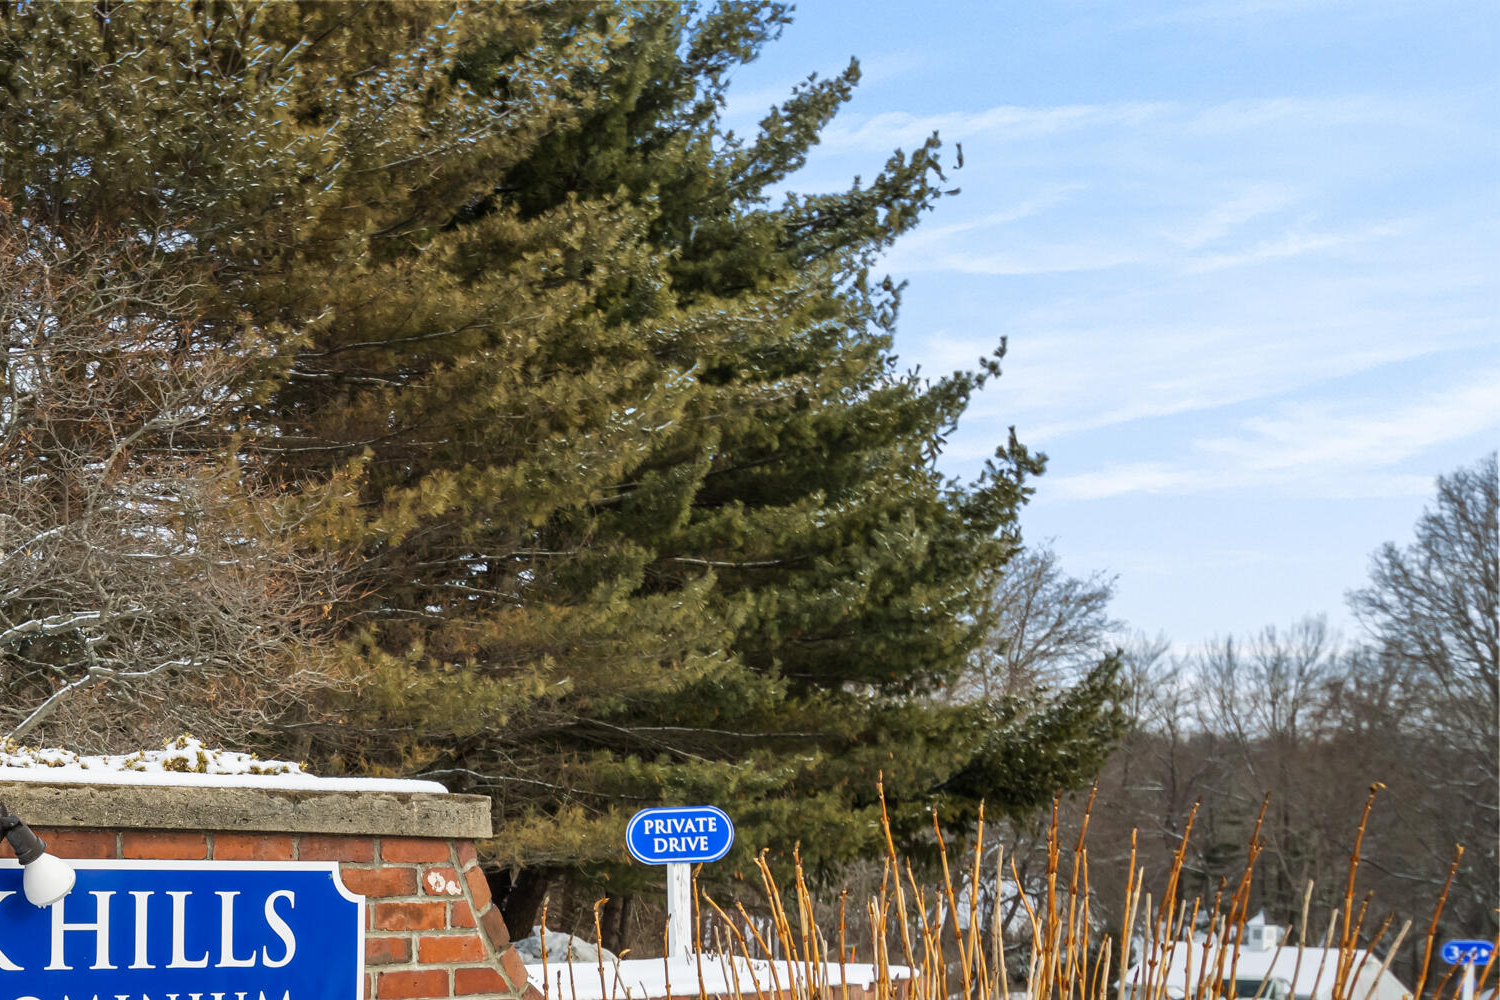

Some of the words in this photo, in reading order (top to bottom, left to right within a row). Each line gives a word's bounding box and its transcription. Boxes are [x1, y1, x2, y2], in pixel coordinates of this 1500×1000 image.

[643, 816, 718, 835] PRIVATE
[653, 836, 709, 853] DRIVE
[43, 889, 297, 971] HILLS
